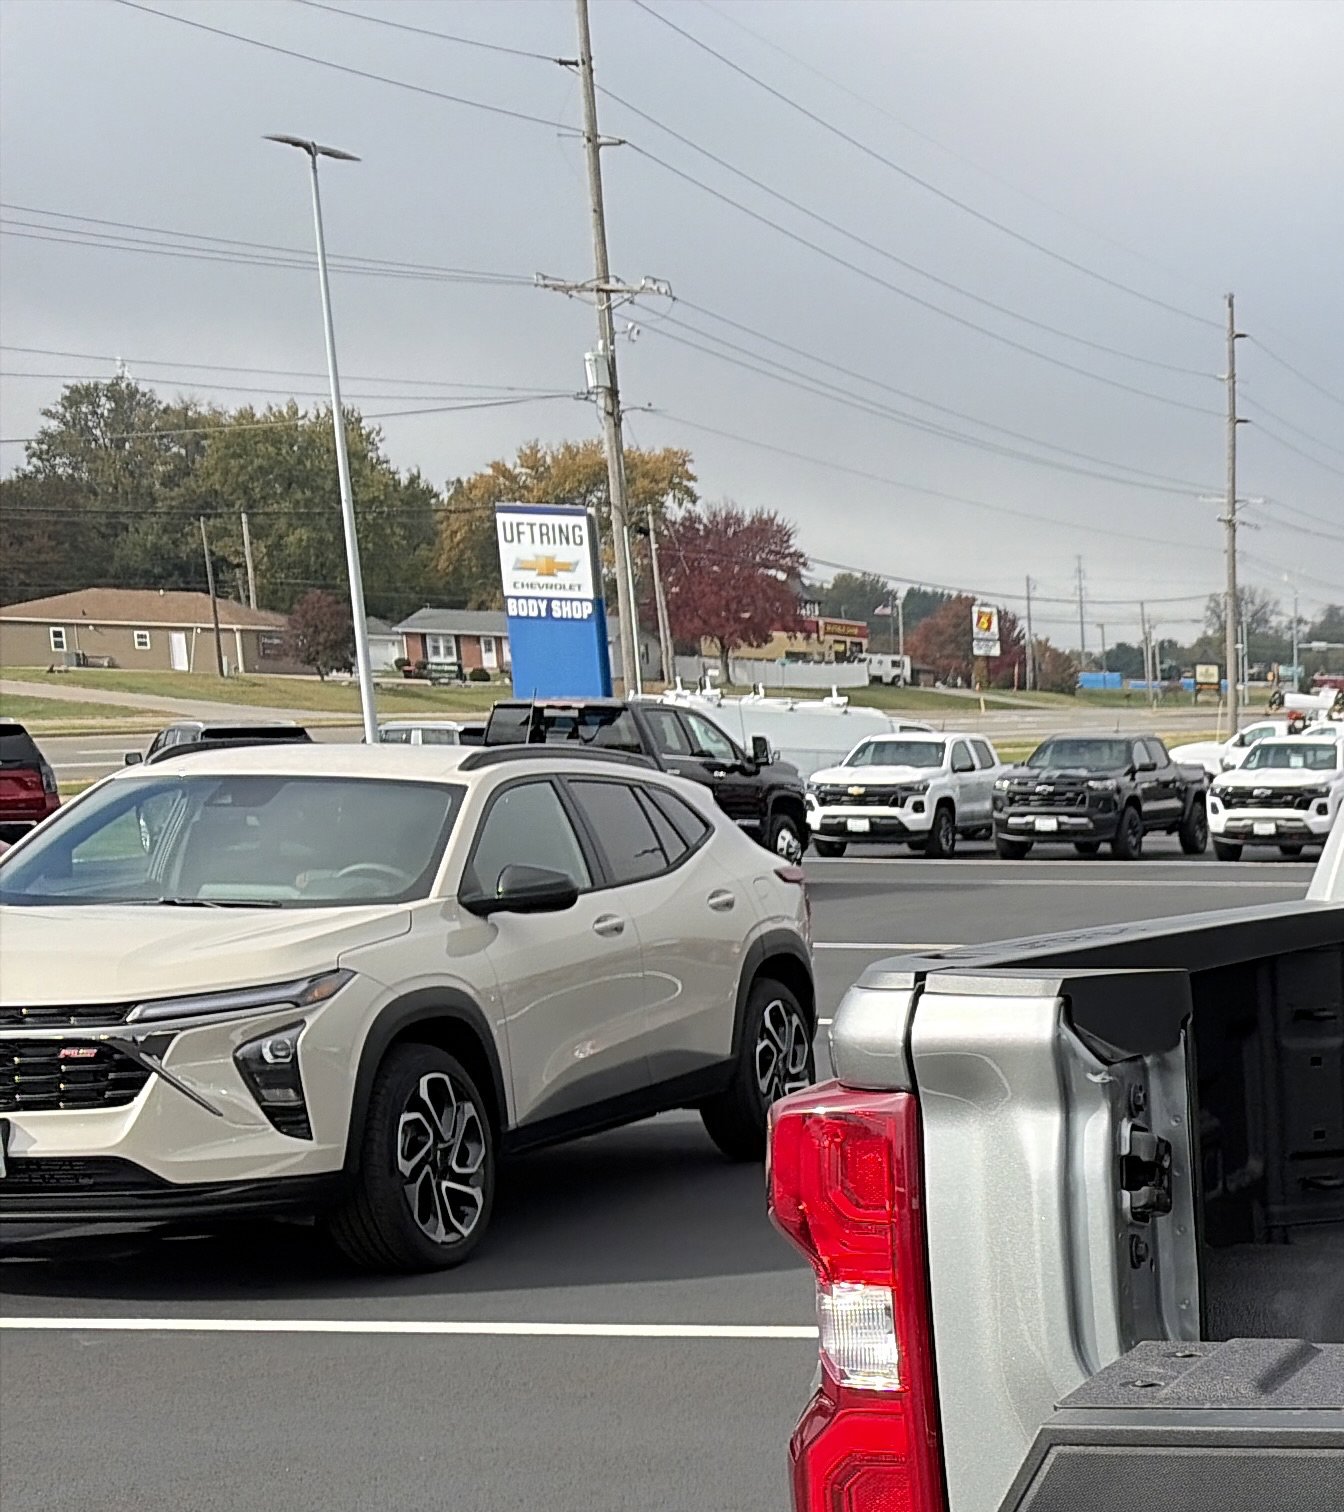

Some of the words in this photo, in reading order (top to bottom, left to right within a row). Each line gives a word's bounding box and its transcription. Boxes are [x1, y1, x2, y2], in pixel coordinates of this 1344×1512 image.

[502, 521, 584, 546] UFTRING
[513, 580, 583, 592] CHEVROLET
[507, 597, 549, 617] BODY
[551, 600, 593, 619] SHOP
